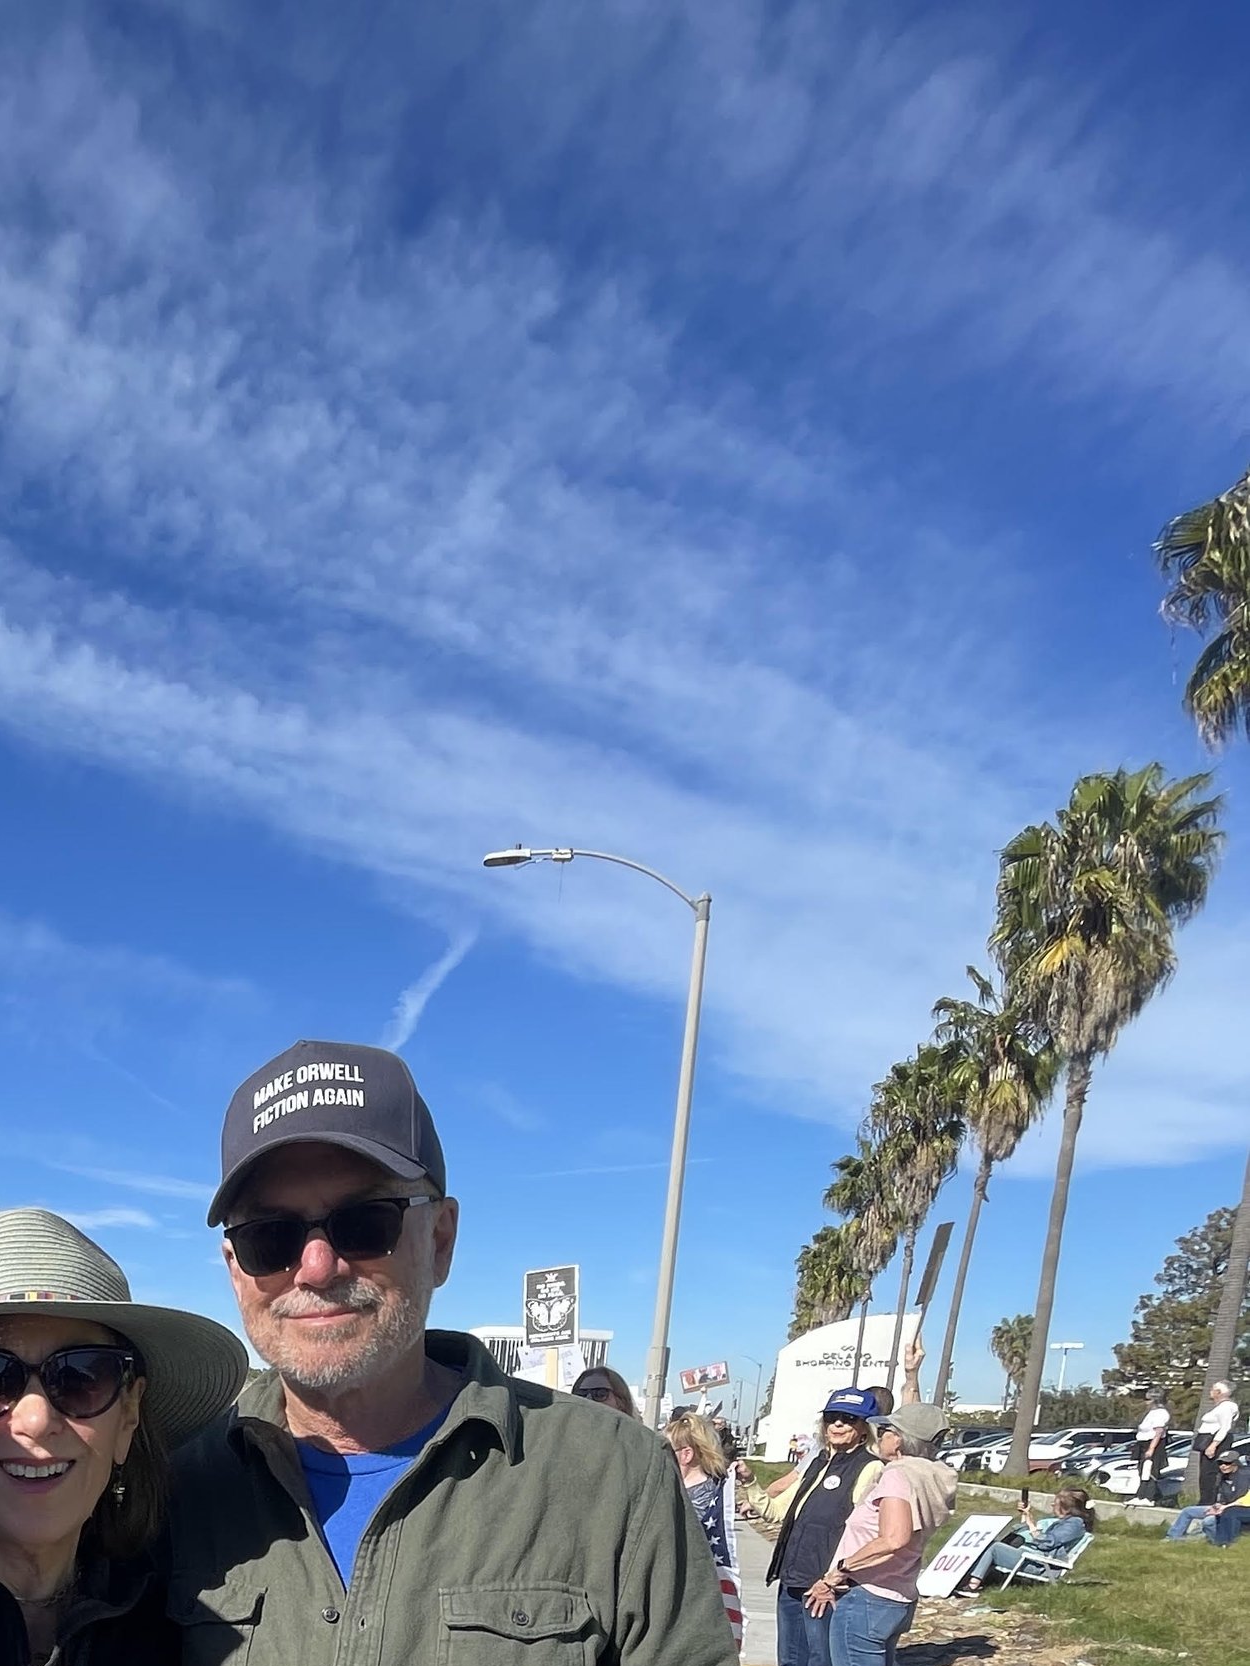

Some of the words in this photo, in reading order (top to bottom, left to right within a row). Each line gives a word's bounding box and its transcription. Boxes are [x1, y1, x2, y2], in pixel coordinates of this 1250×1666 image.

[253, 1070, 294, 1109] MAKE
[296, 1062, 365, 1084] ORWELL
[253, 1091, 309, 1135] FICTION
[312, 1088, 365, 1108] AGAIN
[952, 1530, 992, 1548] ICE
[933, 1554, 970, 1573] OUT
